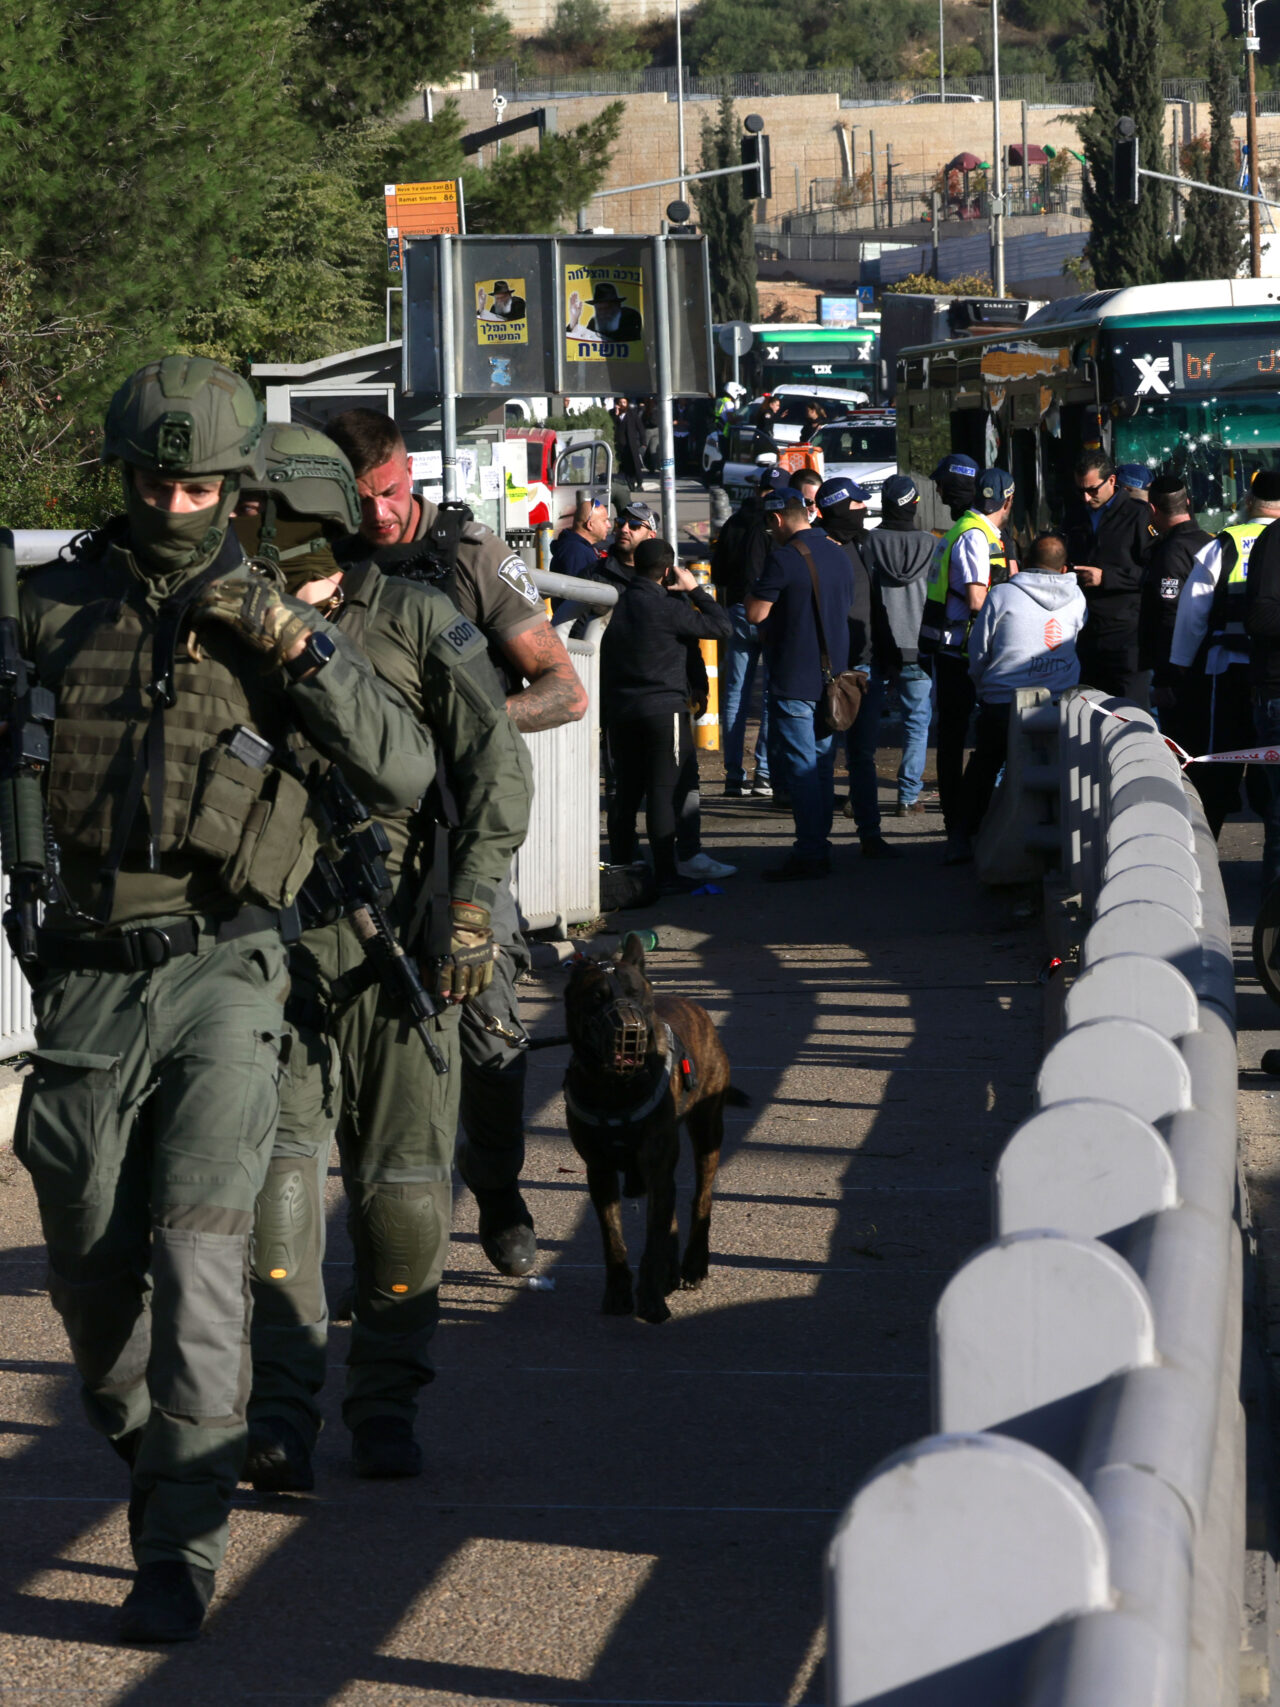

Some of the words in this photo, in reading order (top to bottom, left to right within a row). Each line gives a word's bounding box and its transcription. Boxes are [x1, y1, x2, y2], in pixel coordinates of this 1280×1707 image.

[444, 183, 453, 191] 81
[567, 267, 610, 281] והצלחה
[613, 270, 641, 282] ברכה
[480, 323, 507, 335] המלך
[509, 323, 526, 331] יחי
[487, 333, 521, 342] המשיח
[578, 342, 630, 358] משיח
